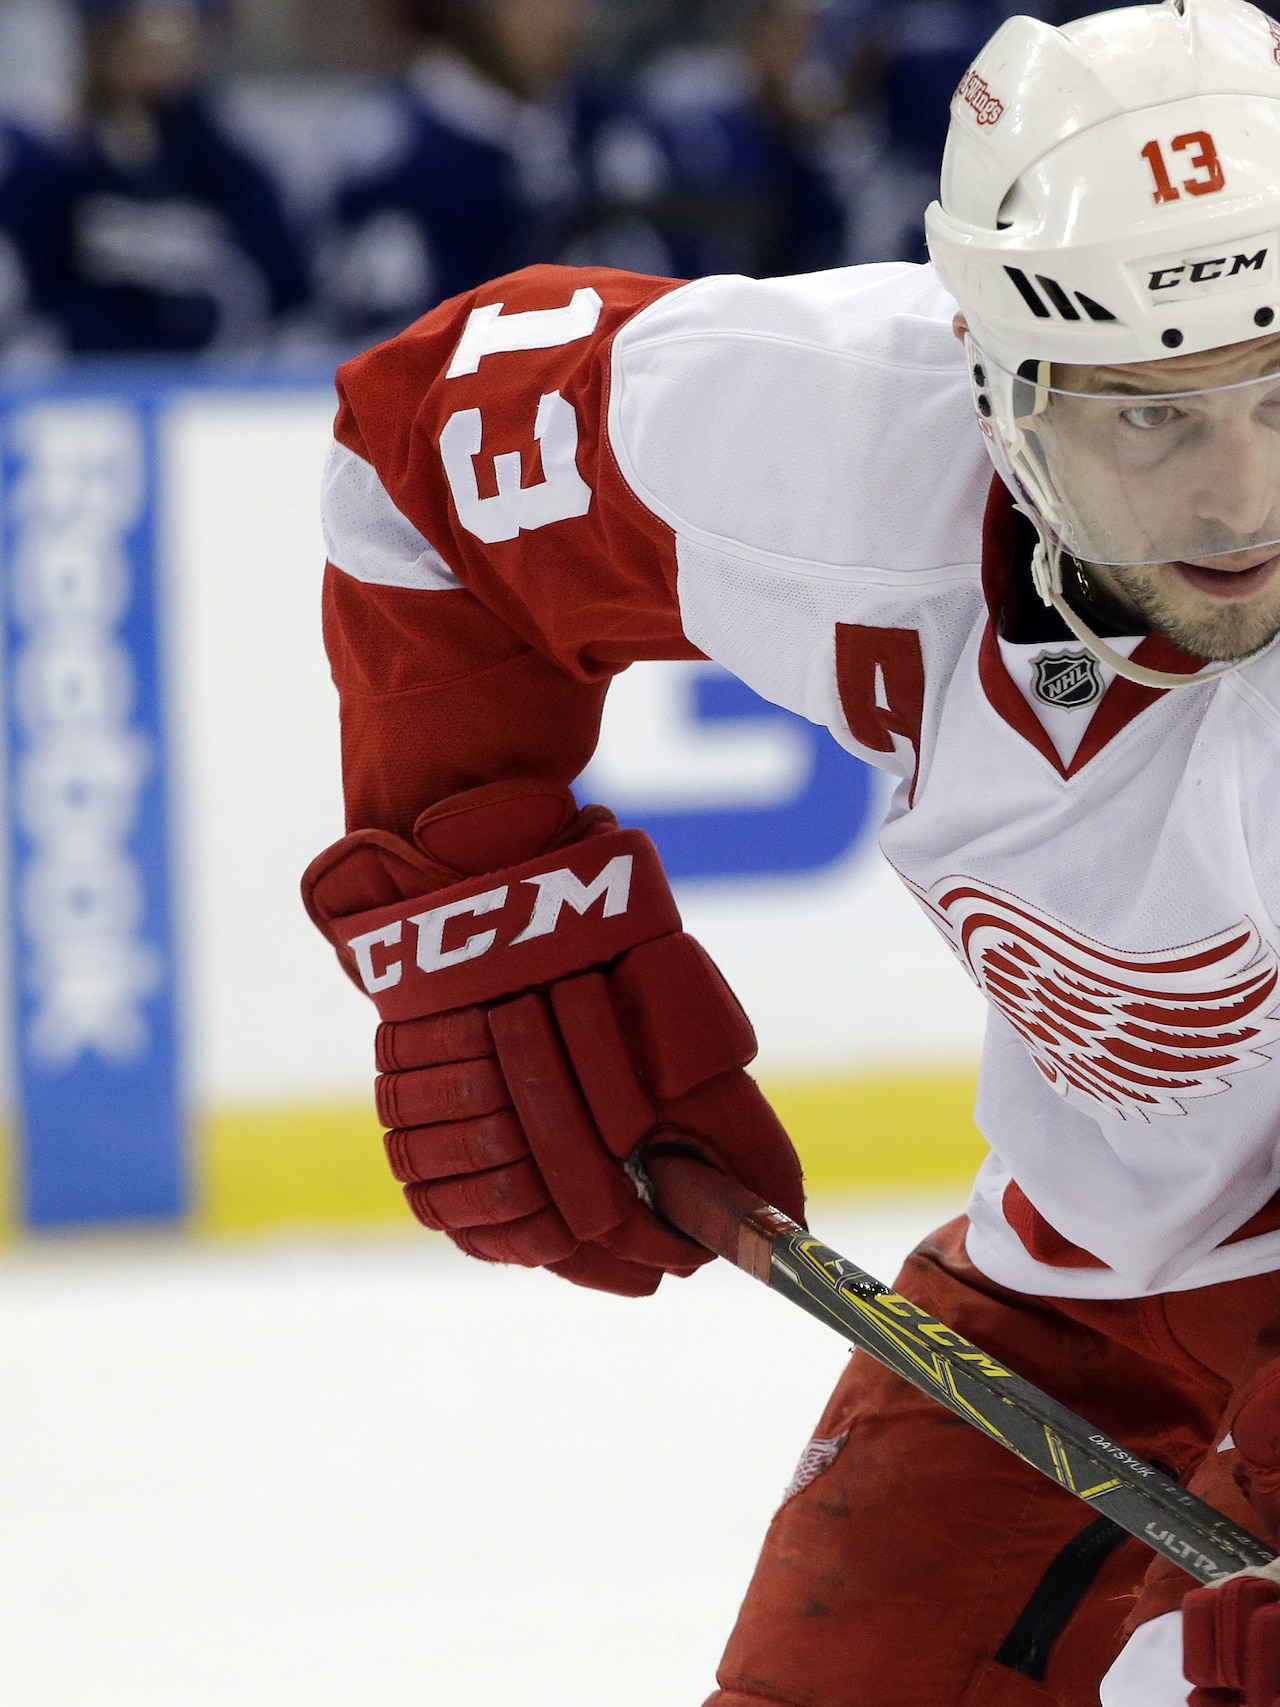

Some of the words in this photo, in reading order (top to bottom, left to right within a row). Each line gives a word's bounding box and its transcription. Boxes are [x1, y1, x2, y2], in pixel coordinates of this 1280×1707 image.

[965, 74, 1004, 125] Wings
[1141, 131, 1225, 204] 13
[1147, 248, 1268, 291] CCM
[440, 287, 603, 544] 13
[1048, 665, 1088, 698] NHL
[347, 854, 634, 994] CCM
[875, 1293, 1013, 1378] CCM
[1087, 1434, 1156, 1478] DATSYUK
